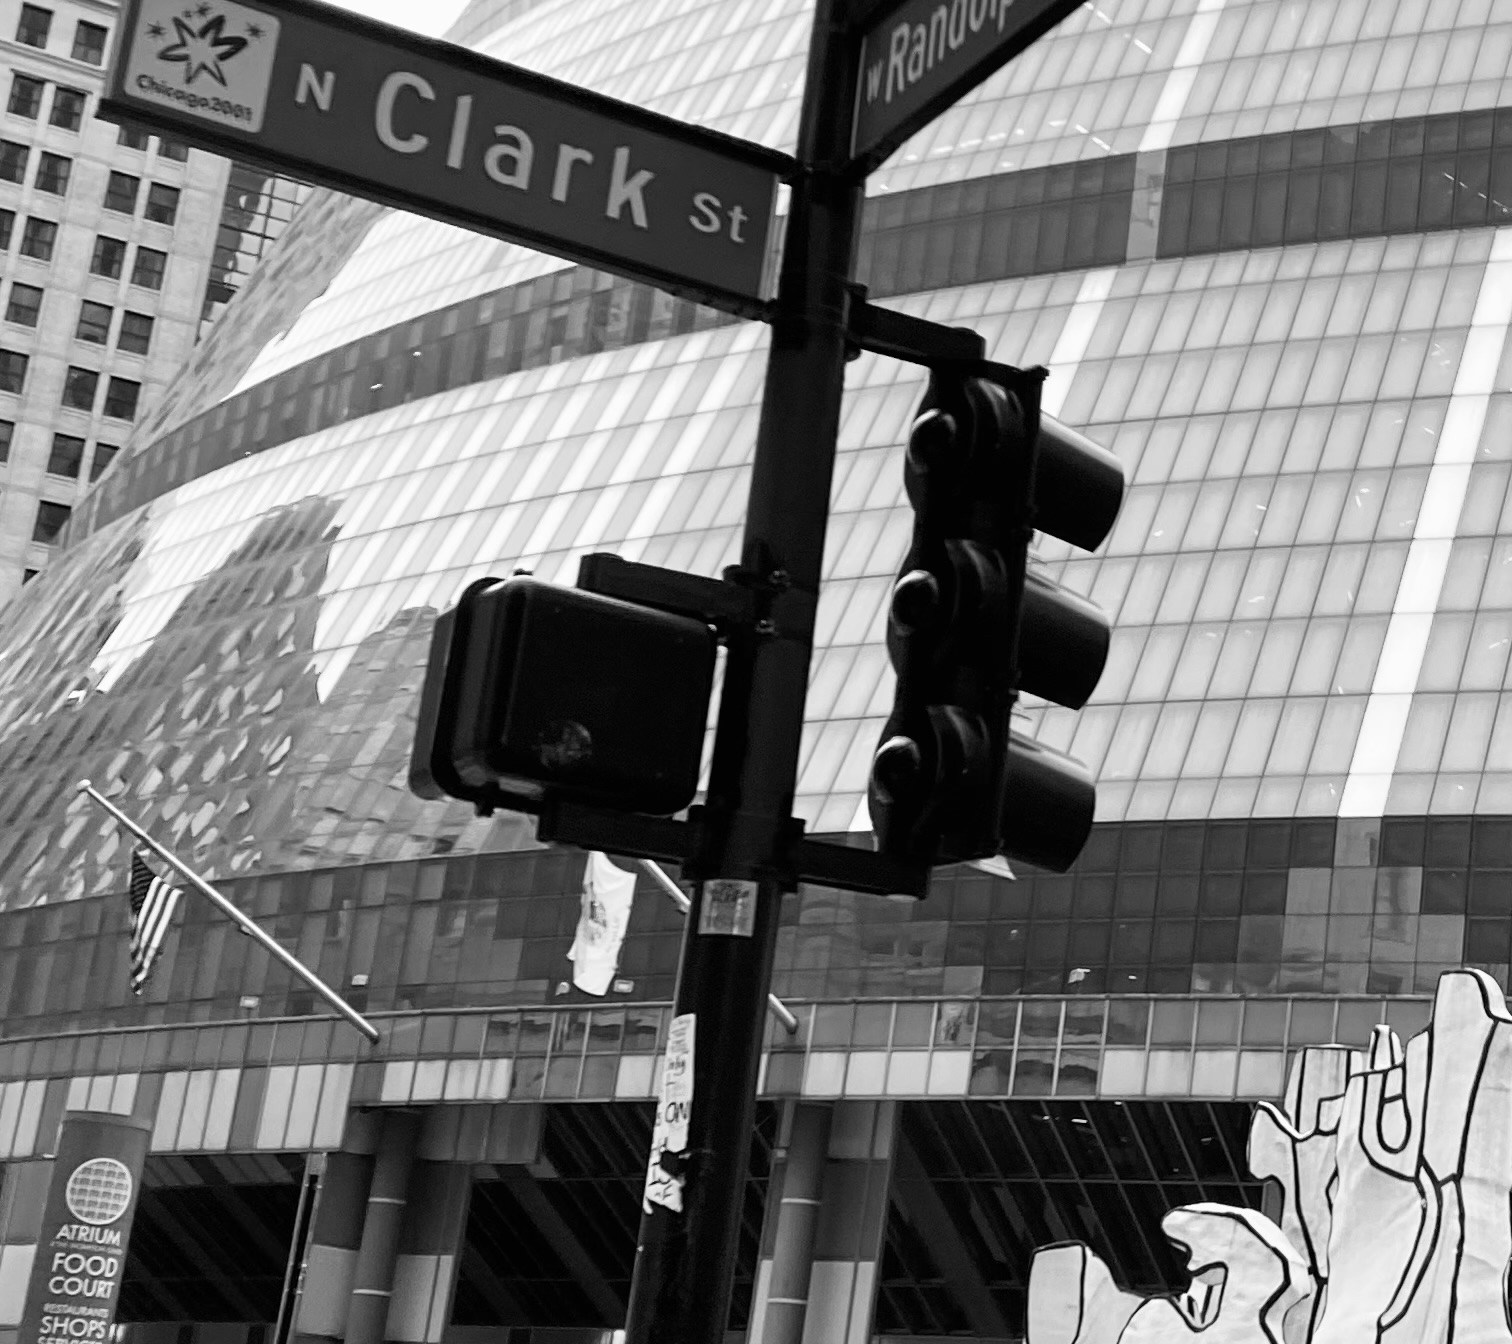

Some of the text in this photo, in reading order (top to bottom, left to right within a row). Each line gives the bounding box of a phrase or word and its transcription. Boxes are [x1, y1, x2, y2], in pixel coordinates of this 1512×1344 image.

[295, 62, 751, 244] N Clark St
[56, 1224, 121, 1246] ATRIUM
[51, 1252, 119, 1278] FOOD
[48, 1276, 115, 1299] COURT
[39, 1315, 107, 1340] SHOPS
